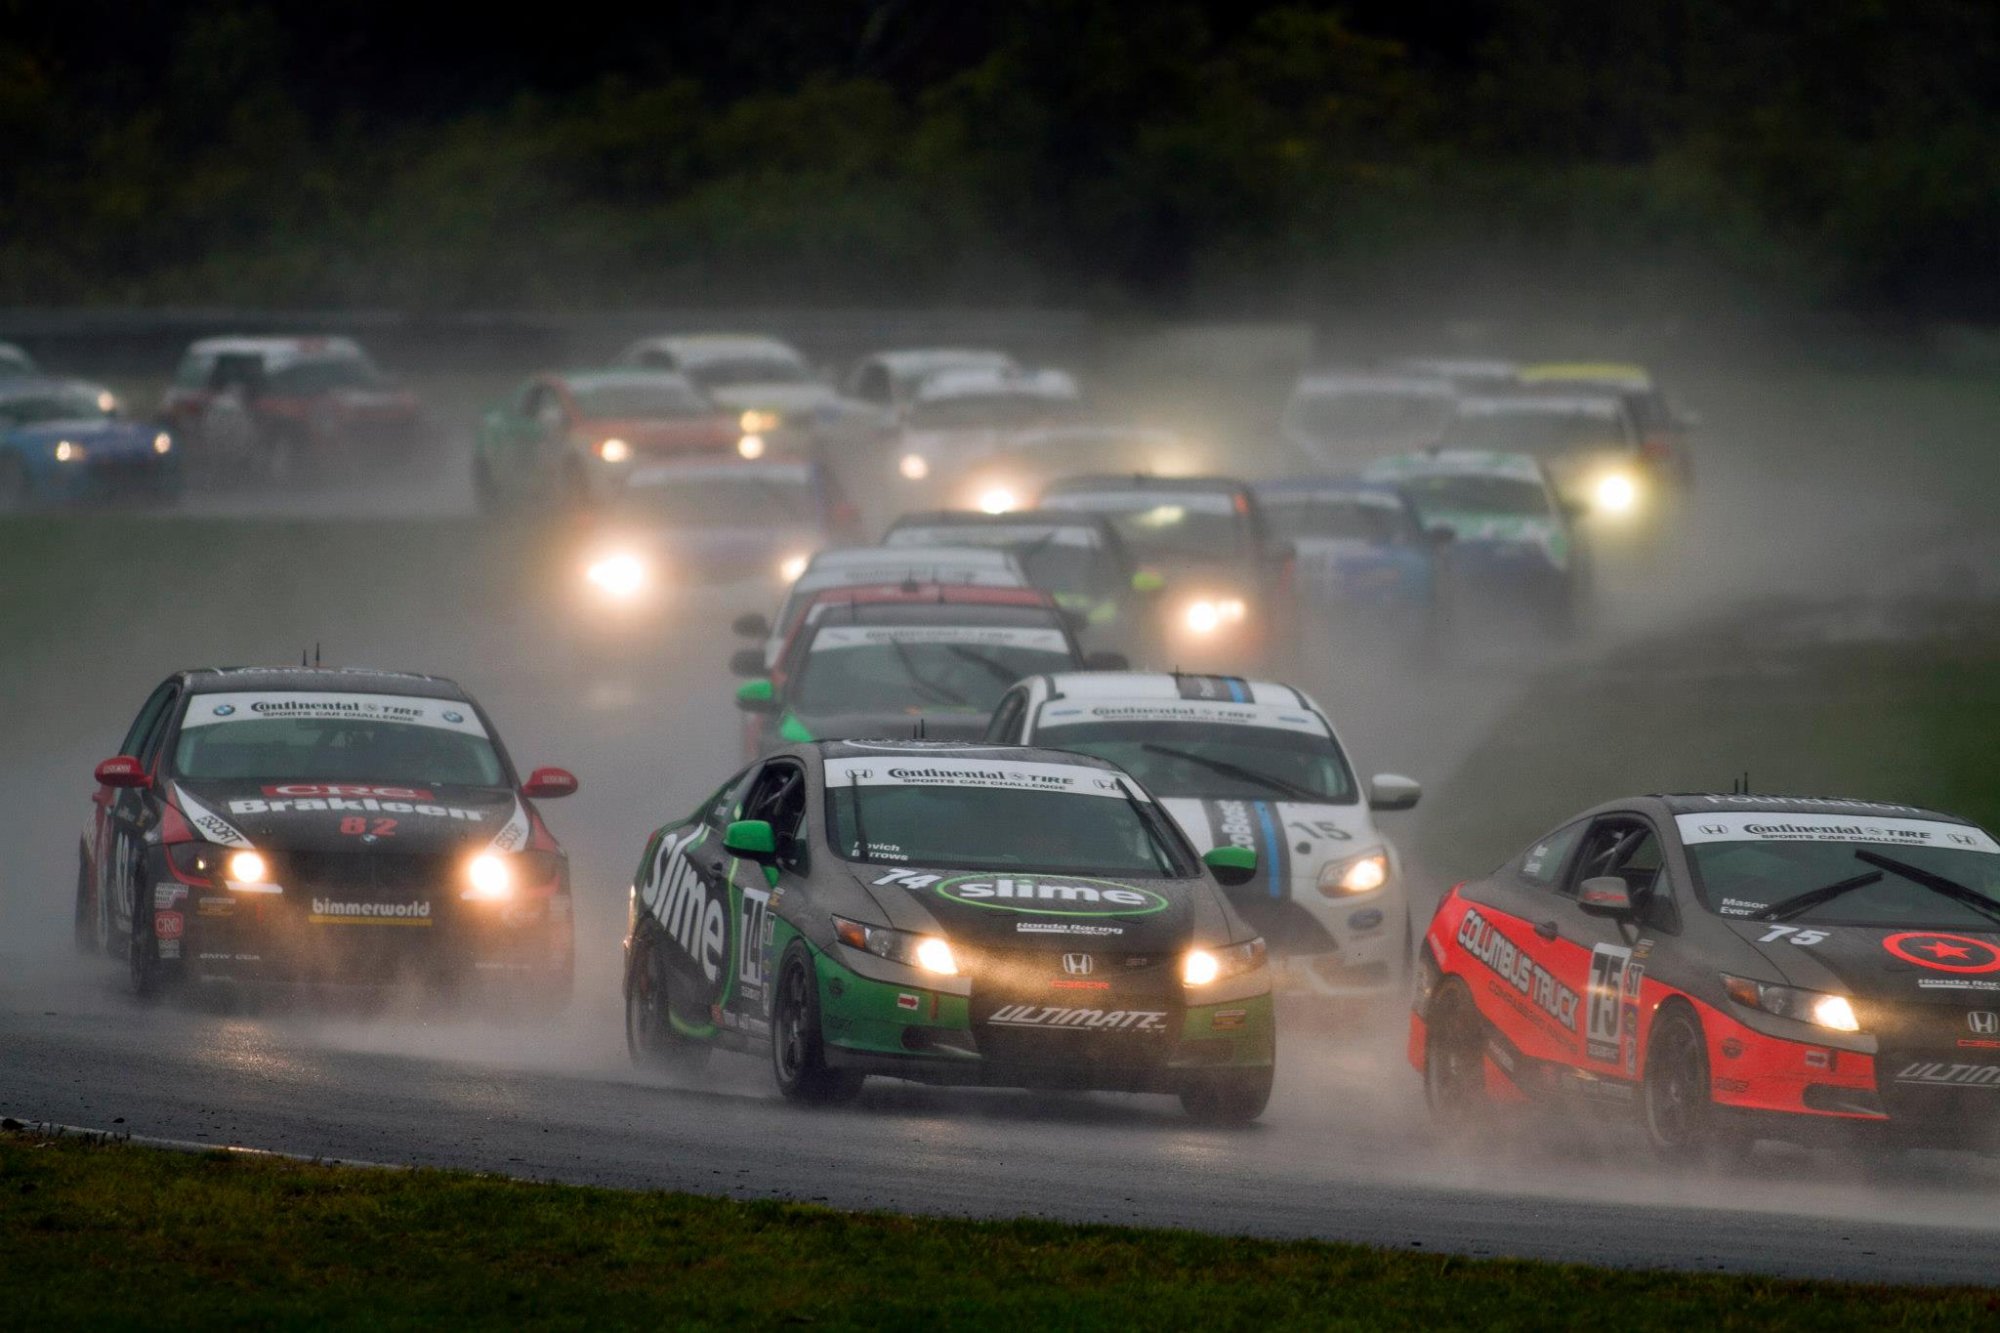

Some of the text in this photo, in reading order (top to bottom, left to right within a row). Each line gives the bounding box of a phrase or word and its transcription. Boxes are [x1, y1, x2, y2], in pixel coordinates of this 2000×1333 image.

[251, 701, 424, 717] Continental TIRE
[887, 767, 1075, 785] Continental TIRE
[989, 780, 1067, 790] CHALLENGE
[228, 797, 484, 822] Brakleen
[339, 815, 400, 836] 82
[1287, 820, 1353, 841] 15
[1743, 824, 1932, 840] Continental TIRE
[1849, 836, 1927, 845] CHALLENGE
[872, 868, 942, 890] 74
[959, 879, 1147, 905] slime
[312, 898, 431, 917] bimmerworld
[1016, 922, 1068, 931] Honda
[1757, 924, 1830, 945] 75
[1457, 907, 1534, 996] COLUMBUS
[1531, 962, 1580, 1033] TRUCK
[987, 1004, 1168, 1029] ULTIMATE
